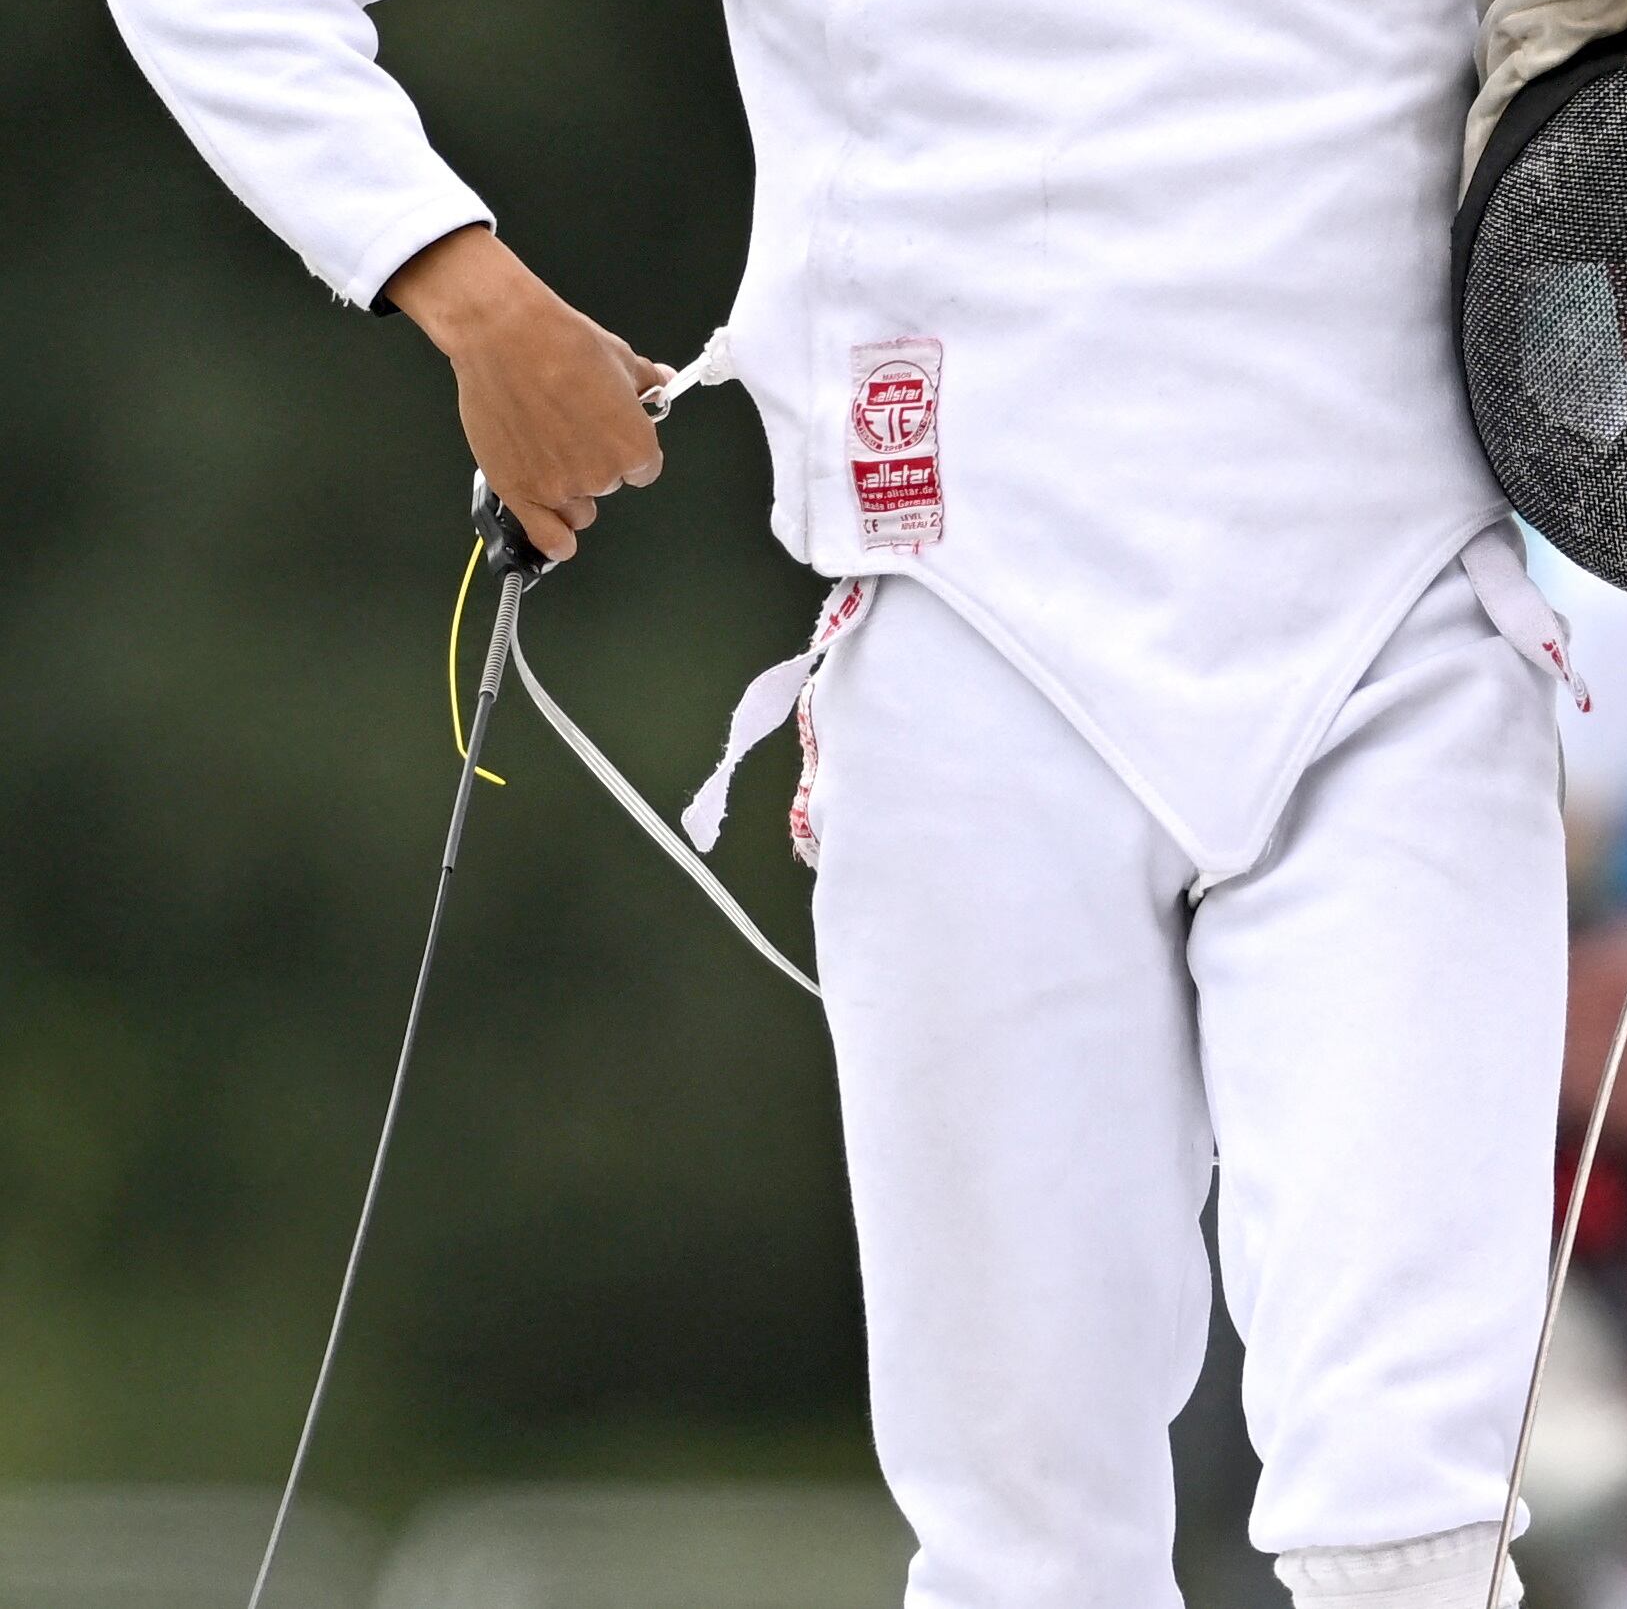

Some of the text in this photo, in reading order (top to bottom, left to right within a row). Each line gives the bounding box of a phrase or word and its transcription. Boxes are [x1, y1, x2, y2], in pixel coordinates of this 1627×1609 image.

[875, 384, 921, 403] allstar
[861, 405, 925, 443] FIE
[865, 463, 932, 489] allstar
[861, 486, 934, 500] www.allstar.de
[887, 501, 896, 509] in
[897, 499, 936, 508] Germany
[929, 512, 940, 528] 2
